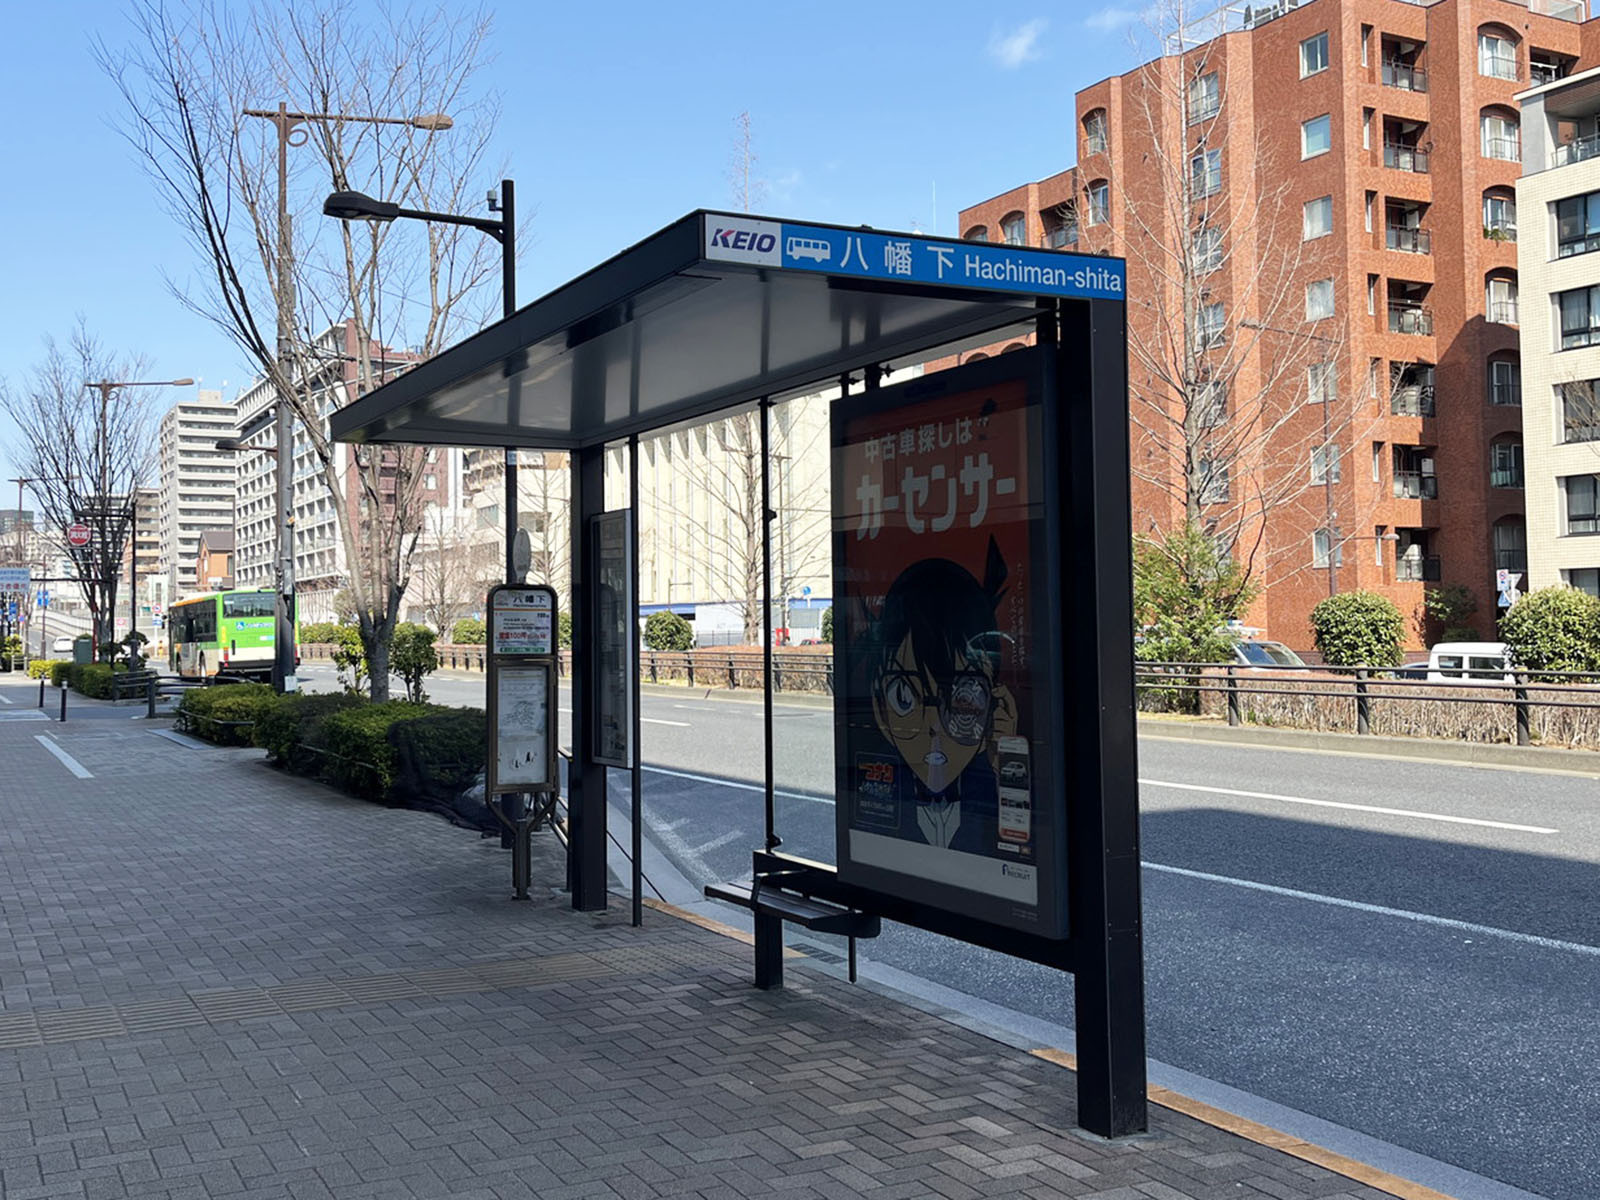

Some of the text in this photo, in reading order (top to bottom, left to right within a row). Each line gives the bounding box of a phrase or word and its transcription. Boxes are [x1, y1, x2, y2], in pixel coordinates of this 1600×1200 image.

[711, 228, 777, 252] KEIO
[840, 235, 955, 279] 八幡下
[965, 254, 1122, 292] Hachiman-shita
[865, 416, 973, 464] 中古車探しは
[856, 453, 1016, 541] カーセンサー
